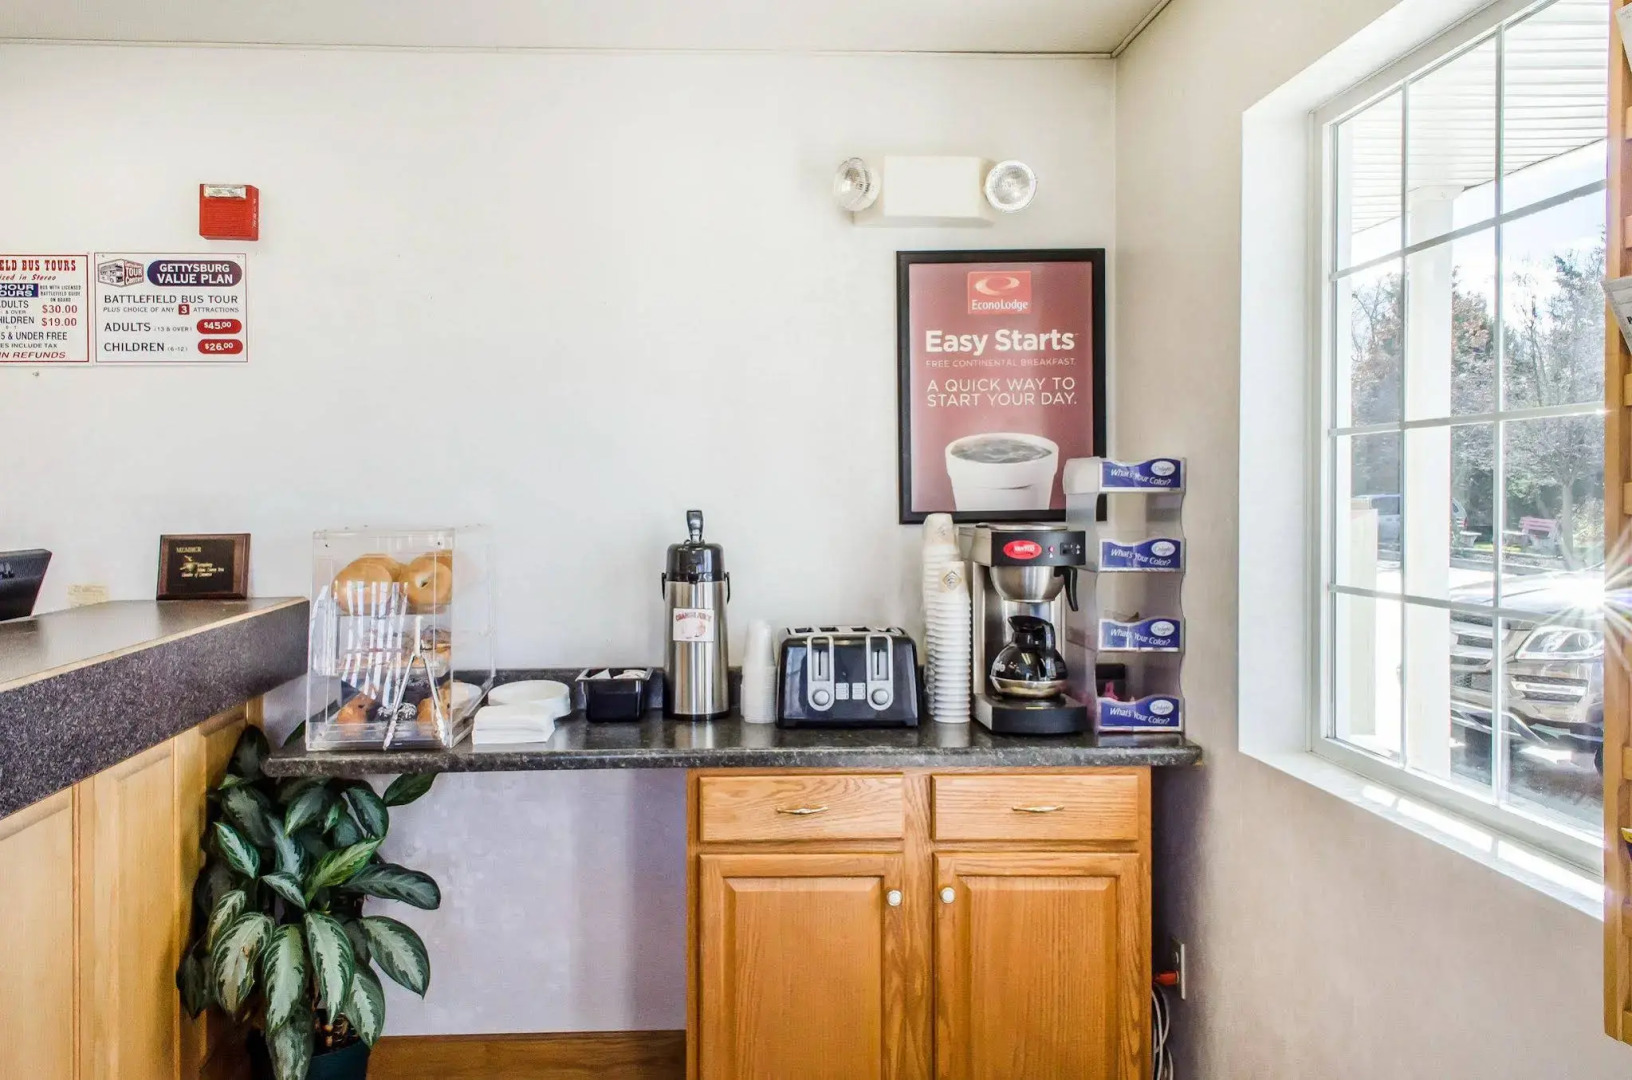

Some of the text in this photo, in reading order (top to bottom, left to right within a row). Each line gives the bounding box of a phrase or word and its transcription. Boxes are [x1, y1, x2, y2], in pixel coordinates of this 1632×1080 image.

[22, 260, 40, 271] BUS
[45, 260, 76, 271] TOURS
[160, 263, 229, 273] GETTYSBURG
[157, 274, 233, 284] VALUE PLAN
[0, 300, 29, 308] DULTS
[104, 295, 238, 304] BATTLEFIELD BUS TOUR
[42, 304, 78, 314] $30.00
[41, 317, 77, 327] $19.00
[104, 322, 151, 332] ADULTS
[203, 321, 232, 330] $45.00
[8, 332, 13, 340] &
[16, 332, 44, 341] UNDER
[47, 332, 67, 341] FREE
[104, 342, 165, 352] CHILDREN
[204, 342, 234, 351] $26.00
[926, 329, 1075, 355] Easy Starts
[13, 351, 66, 359] REFUNDS
[926, 359, 950, 368] FREE
[952, 359, 1017, 367] CONTINENTAL
[927, 377, 1076, 392] A QUICK WAY TO
[927, 392, 1077, 407] START YOUR DAY.
[1149, 476, 1171, 486] Color?
[1149, 556, 1171, 566] Color?
[1148, 636, 1171, 646] Color?
[1147, 715, 1170, 725] Color?
